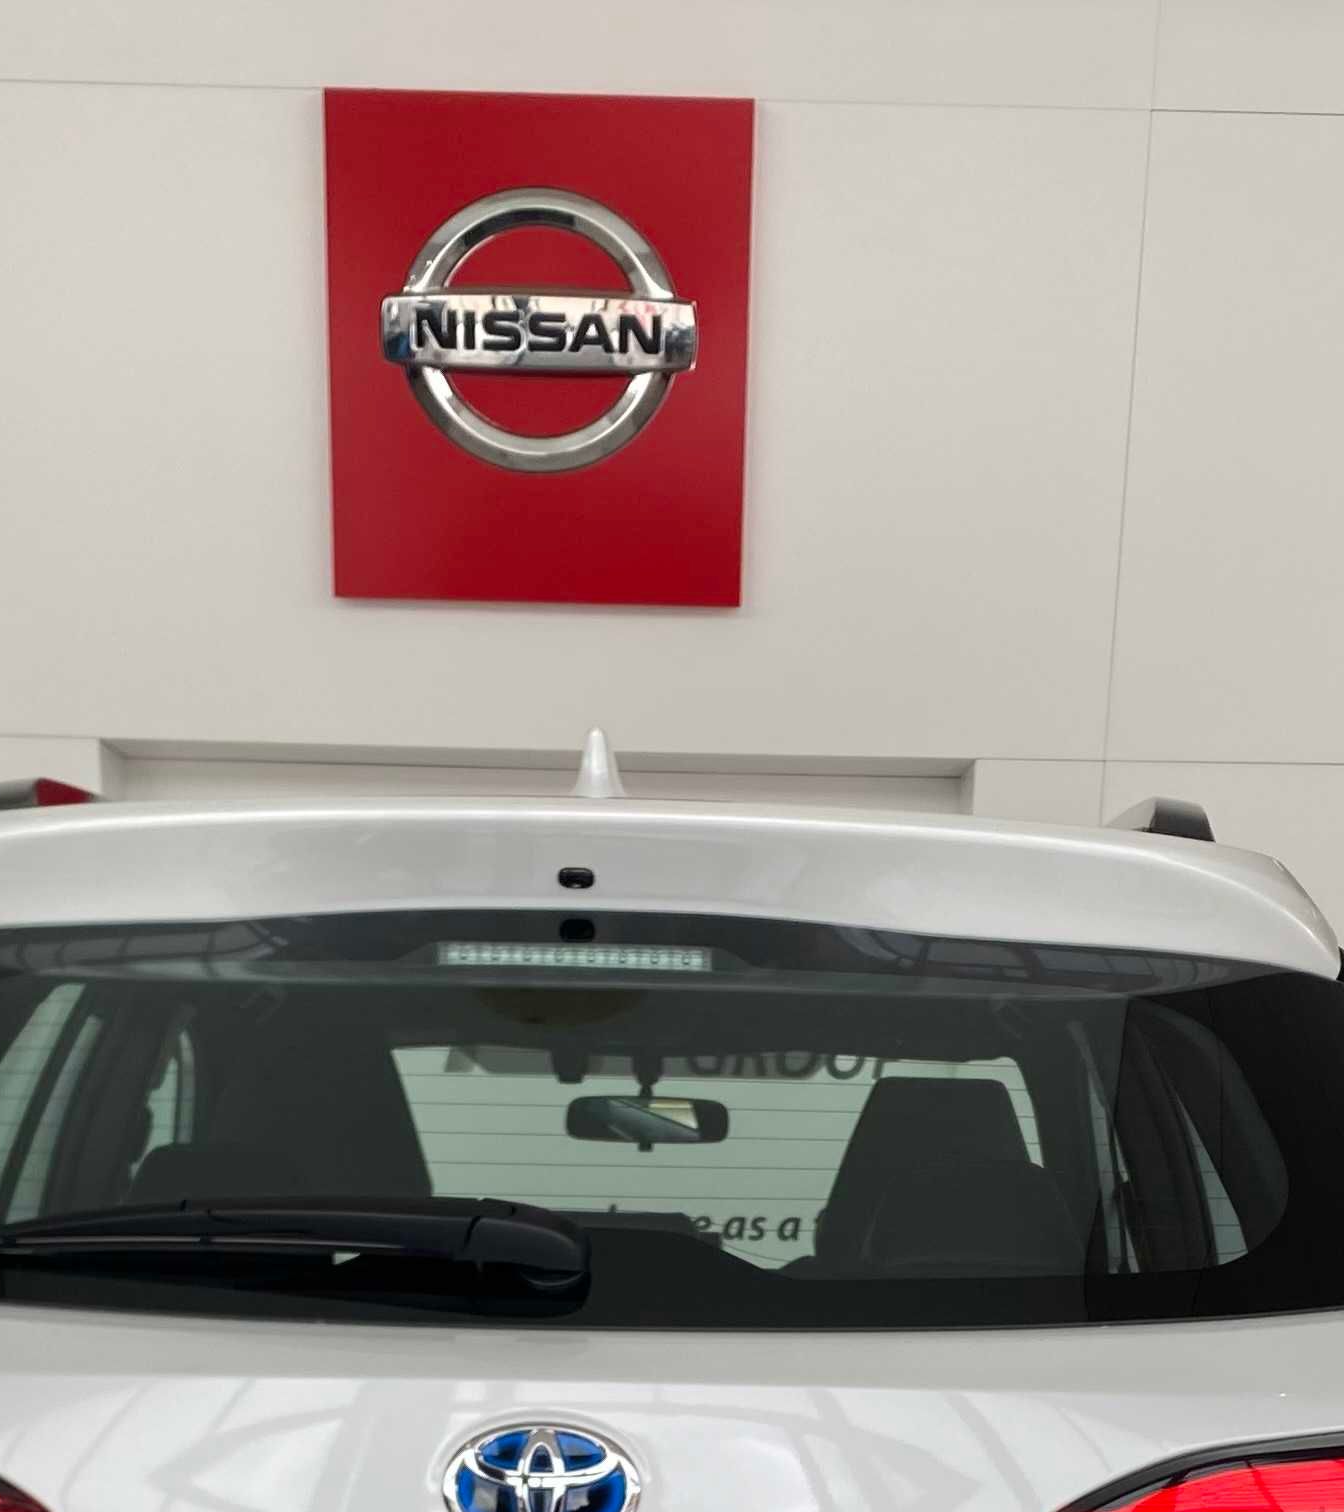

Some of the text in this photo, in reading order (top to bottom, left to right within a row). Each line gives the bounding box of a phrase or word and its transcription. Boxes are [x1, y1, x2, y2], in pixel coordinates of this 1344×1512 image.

[415, 307, 662, 355] NISSAN
[722, 1214, 767, 1241] as
[776, 1215, 802, 1241] a
